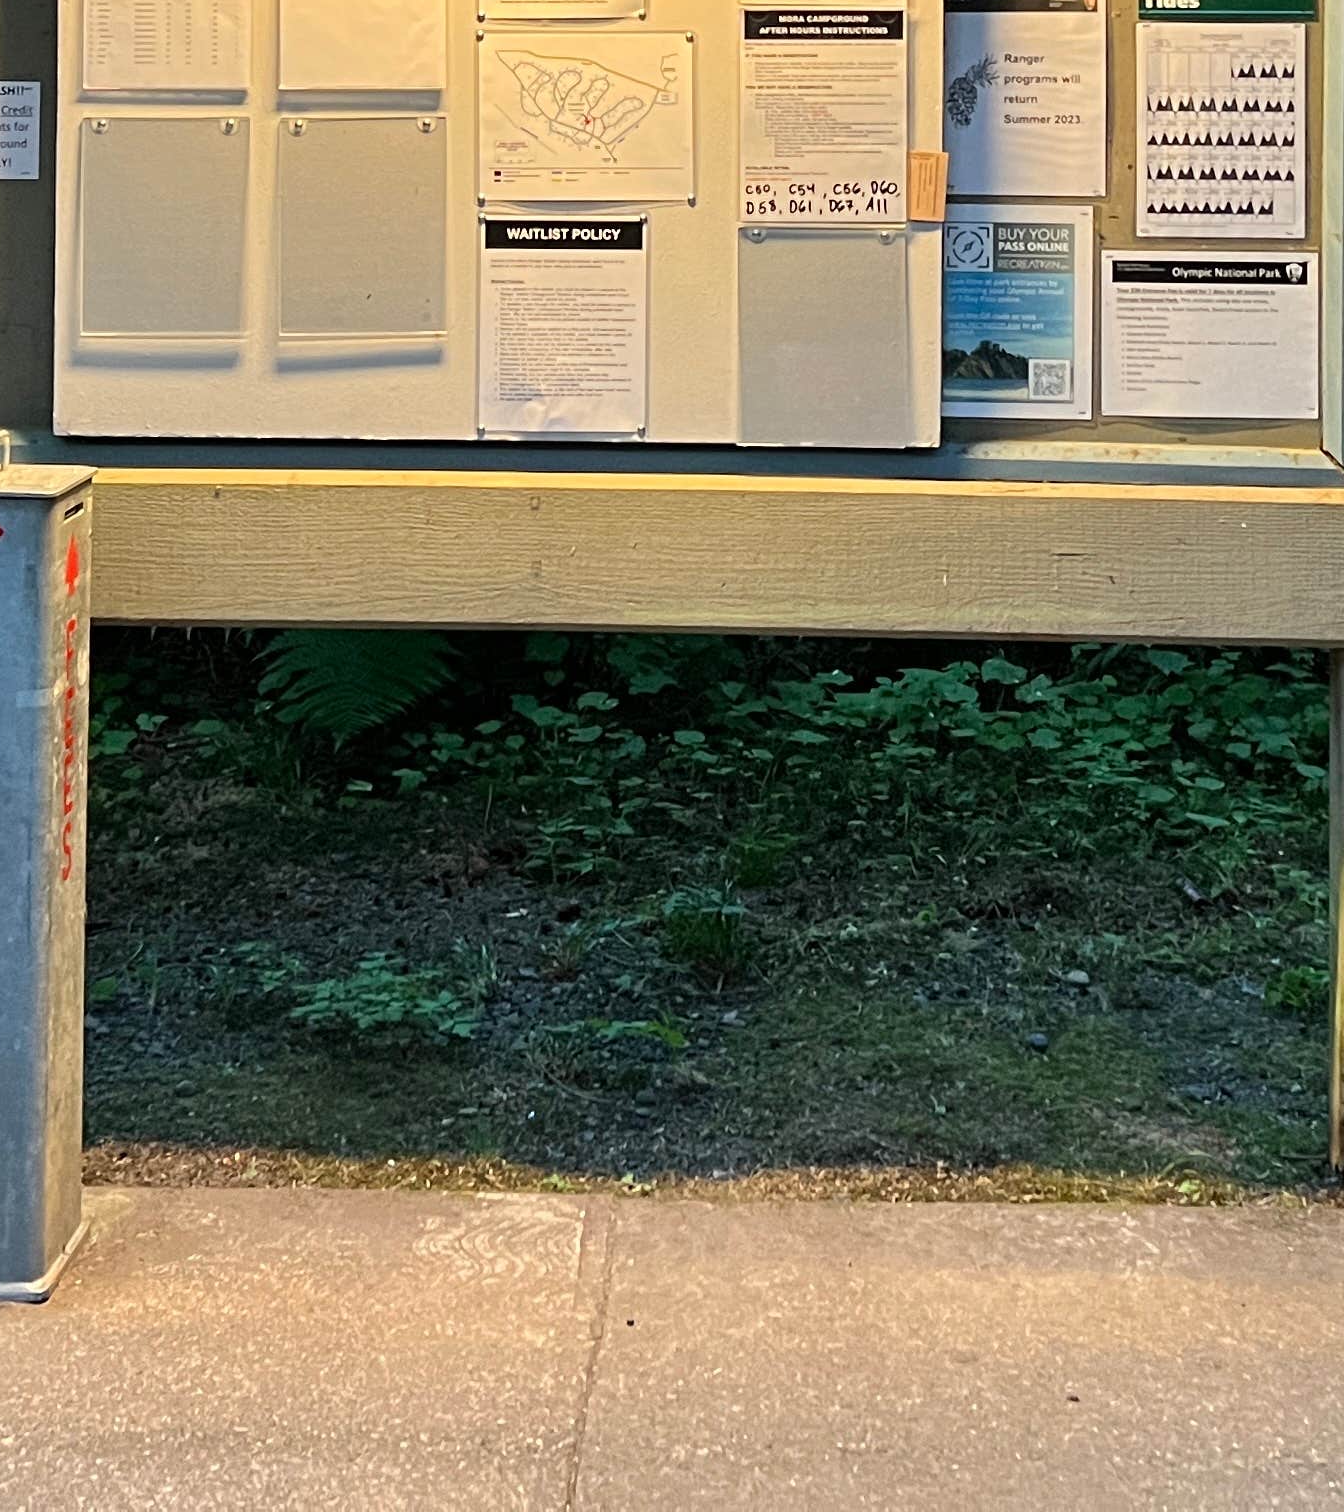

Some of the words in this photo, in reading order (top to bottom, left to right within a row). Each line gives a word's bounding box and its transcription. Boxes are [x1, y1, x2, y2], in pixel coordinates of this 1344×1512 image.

[778, 15, 805, 23] MORA
[806, 15, 869, 24] CAMPGROUND
[759, 27, 788, 35] AFTER
[789, 27, 821, 35] HOURS
[822, 27, 889, 35] INSTRUCTIONS
[1004, 53, 1045, 66] Ranger
[1004, 75, 1058, 87] programs
[1062, 74, 1081, 84] will
[1004, 95, 1038, 104] return
[1, 105, 33, 116] Credit
[1004, 114, 1050, 124] Summer
[14, 121, 29, 132] for
[506, 227, 570, 240] WAITLIST
[572, 228, 621, 241] POLICY
[998, 227, 1026, 241] BUY
[1029, 228, 1069, 241] YOUR
[998, 241, 1025, 252] PASS
[1027, 242, 1069, 252] ONLINE
[1172, 267, 1213, 279] Olympic
[1214, 267, 1257, 278] National
[1258, 268, 1281, 278] Park
